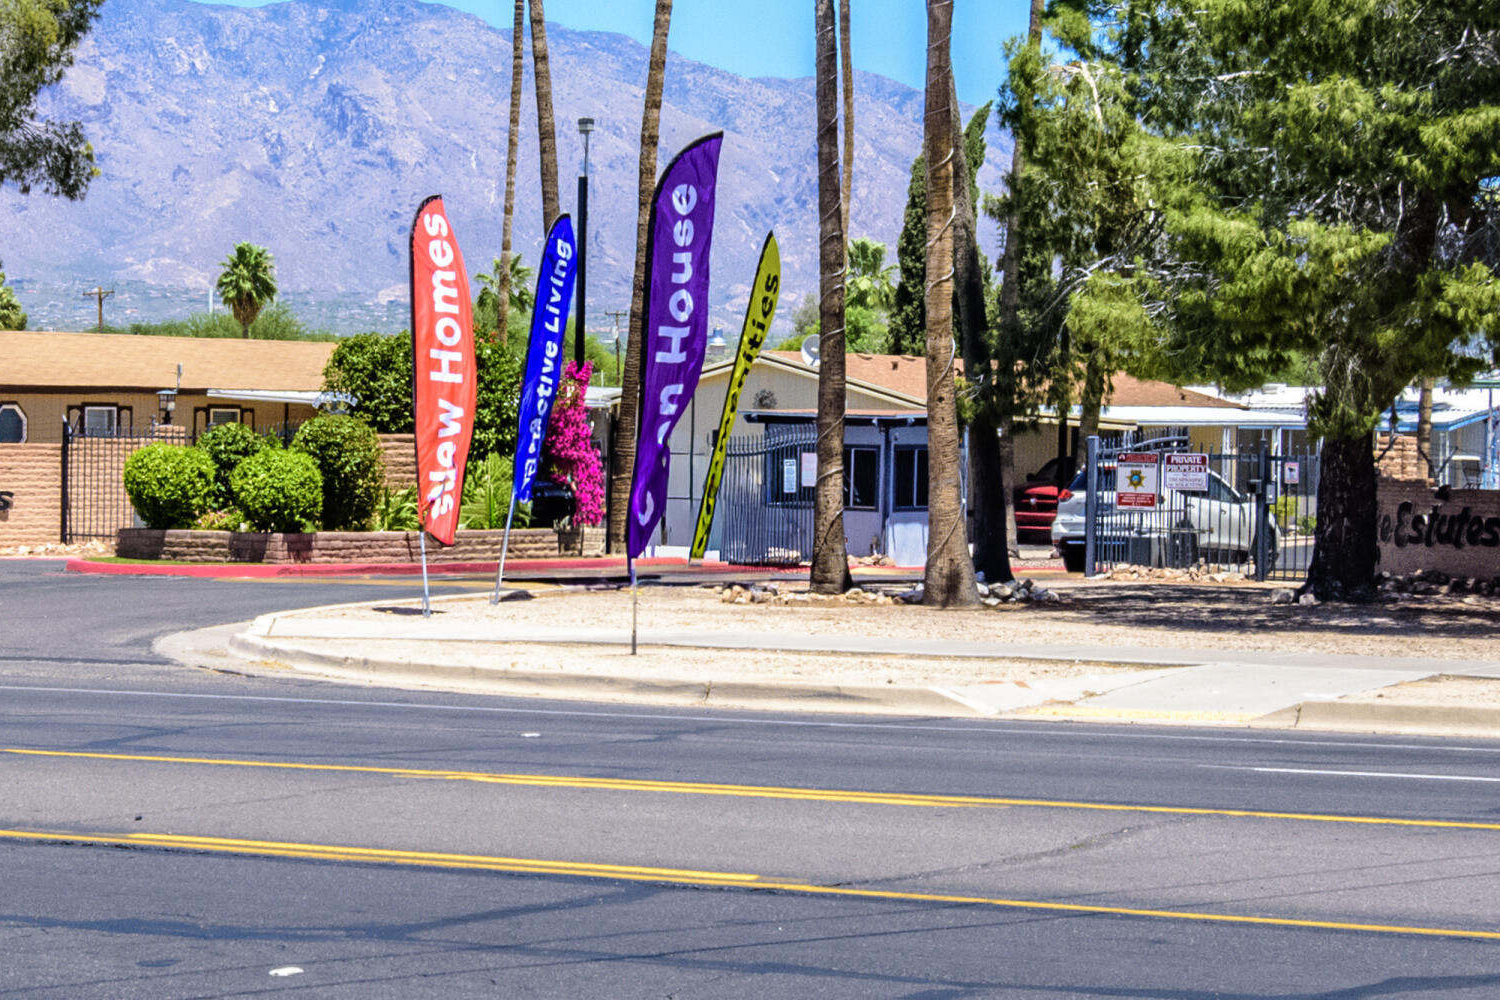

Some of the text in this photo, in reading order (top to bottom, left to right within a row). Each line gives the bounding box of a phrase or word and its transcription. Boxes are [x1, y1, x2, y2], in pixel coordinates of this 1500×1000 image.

[424, 212, 463, 385] Homes
[545, 238, 572, 334] Living
[655, 183, 698, 364] House
[1171, 455, 1202, 464] PRIVATE
[1393, 501, 1500, 548] Estates
